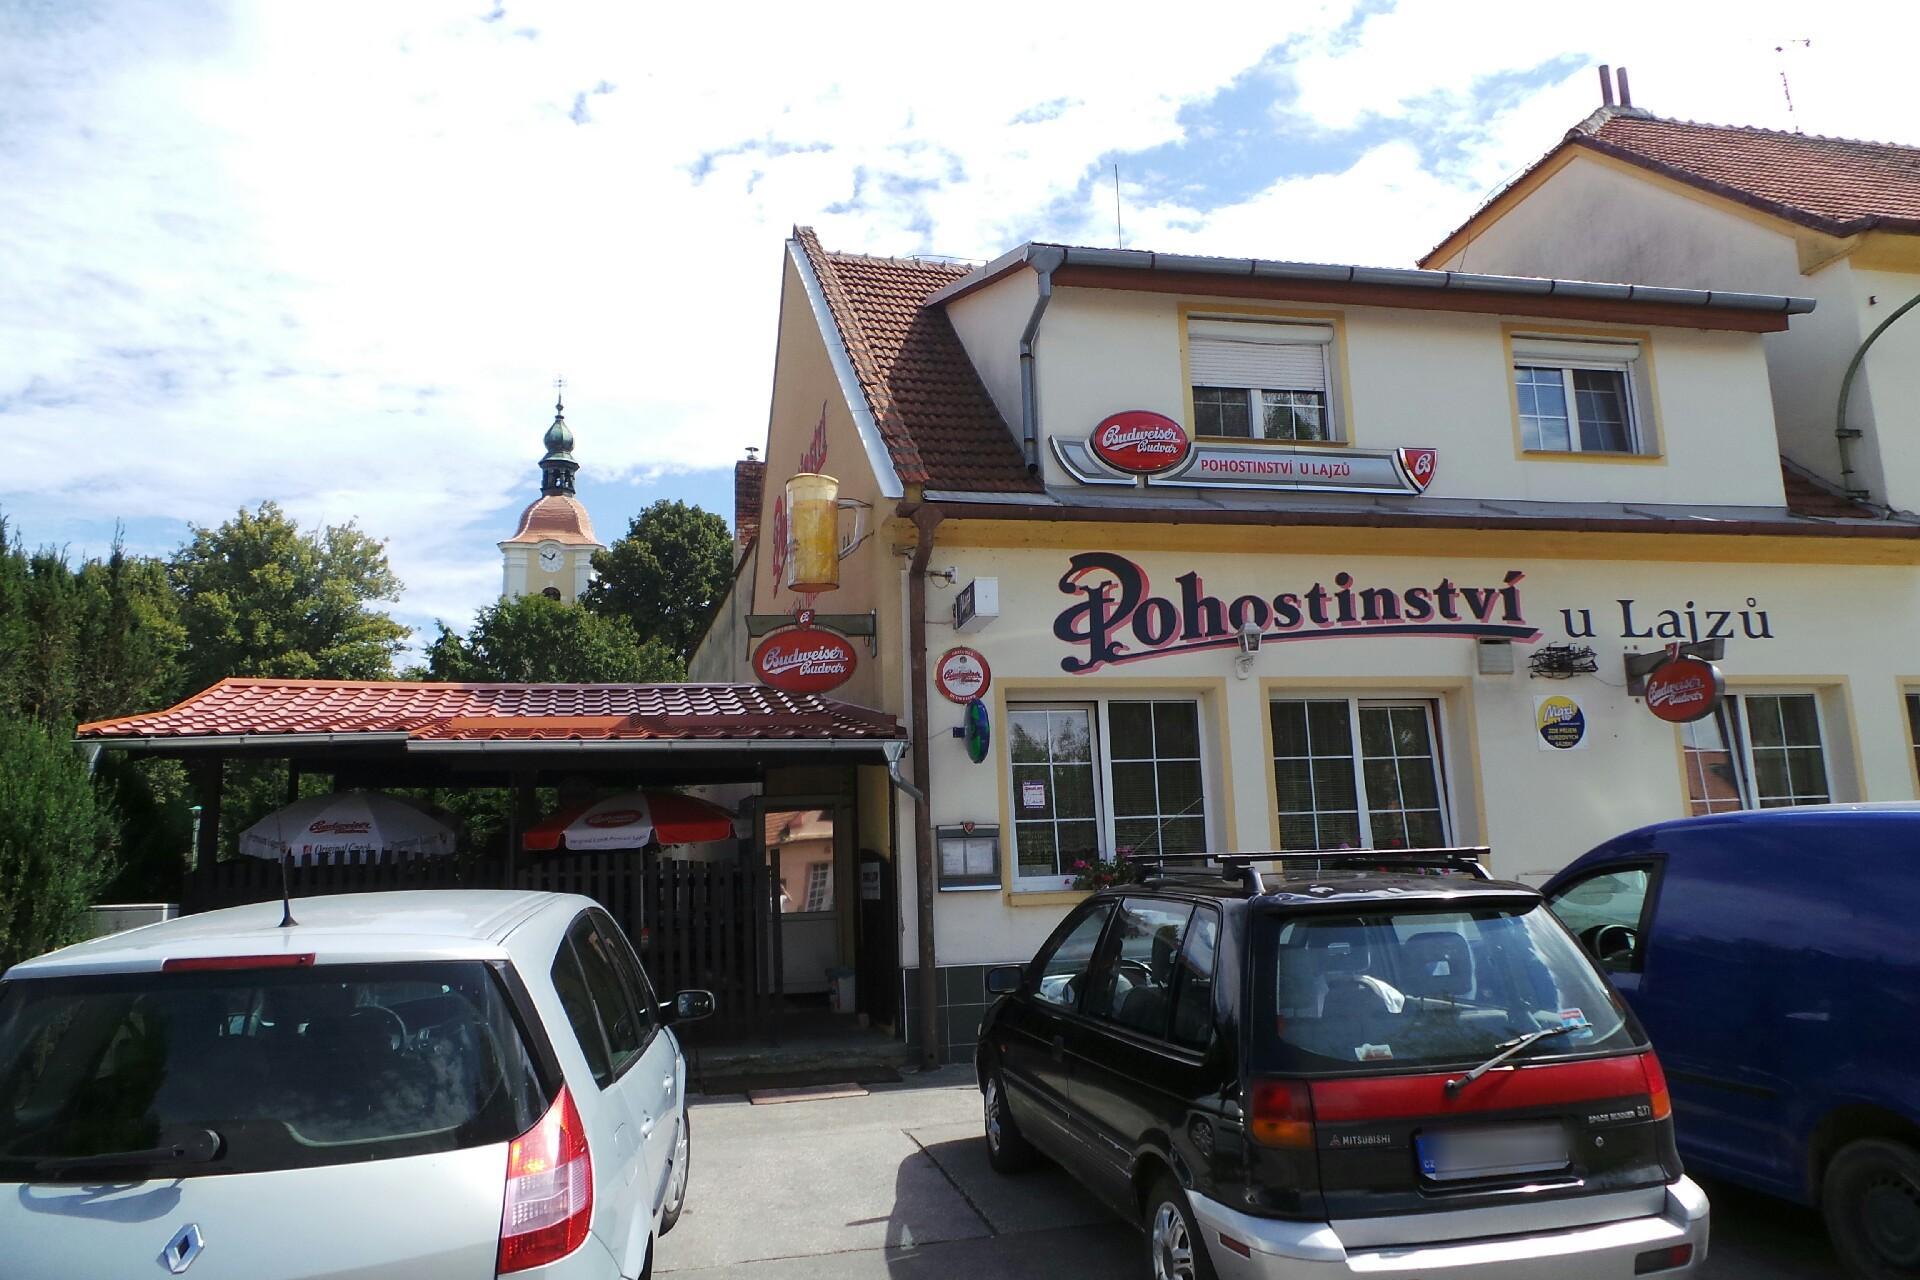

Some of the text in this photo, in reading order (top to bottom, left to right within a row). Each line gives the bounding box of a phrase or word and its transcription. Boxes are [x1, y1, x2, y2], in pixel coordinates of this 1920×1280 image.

[1102, 424, 1180, 449] Budweiser
[1136, 440, 1178, 454] Budvar
[1200, 457, 1351, 478] POHOSTINSTVÍ U LAJZŮ
[1053, 552, 1775, 674] Pohostinství u Lajzů
[762, 645, 848, 672] Budweiser
[799, 661, 846, 675] Budvar
[1342, 1134, 1391, 1145] MITSUBISHI
